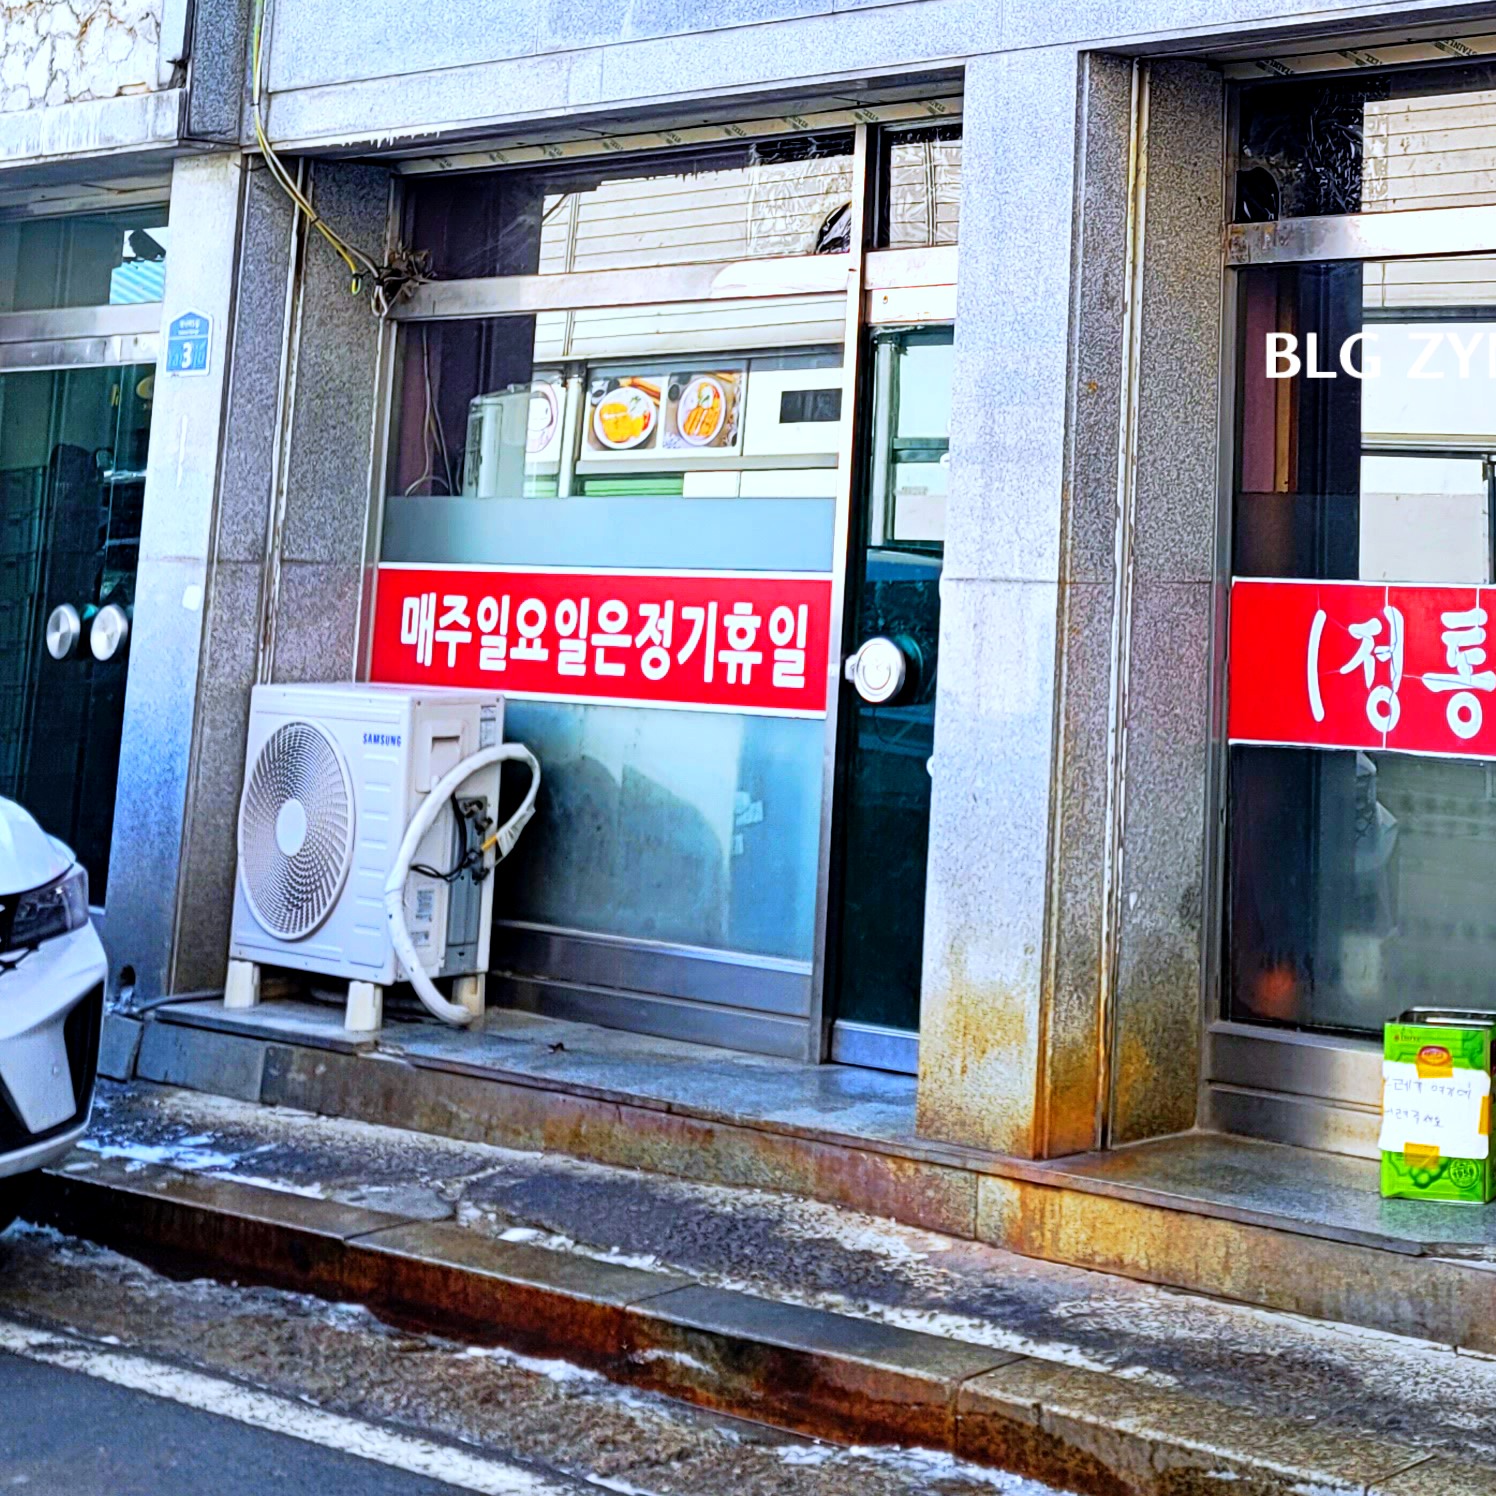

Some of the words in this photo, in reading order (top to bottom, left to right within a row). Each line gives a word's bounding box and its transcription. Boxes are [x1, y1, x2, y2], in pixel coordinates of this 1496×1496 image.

[181, 341, 193, 369] 3
[400, 591, 810, 689] 매주일요일은정기휴일
[362, 733, 402, 747] SAMSUNG
